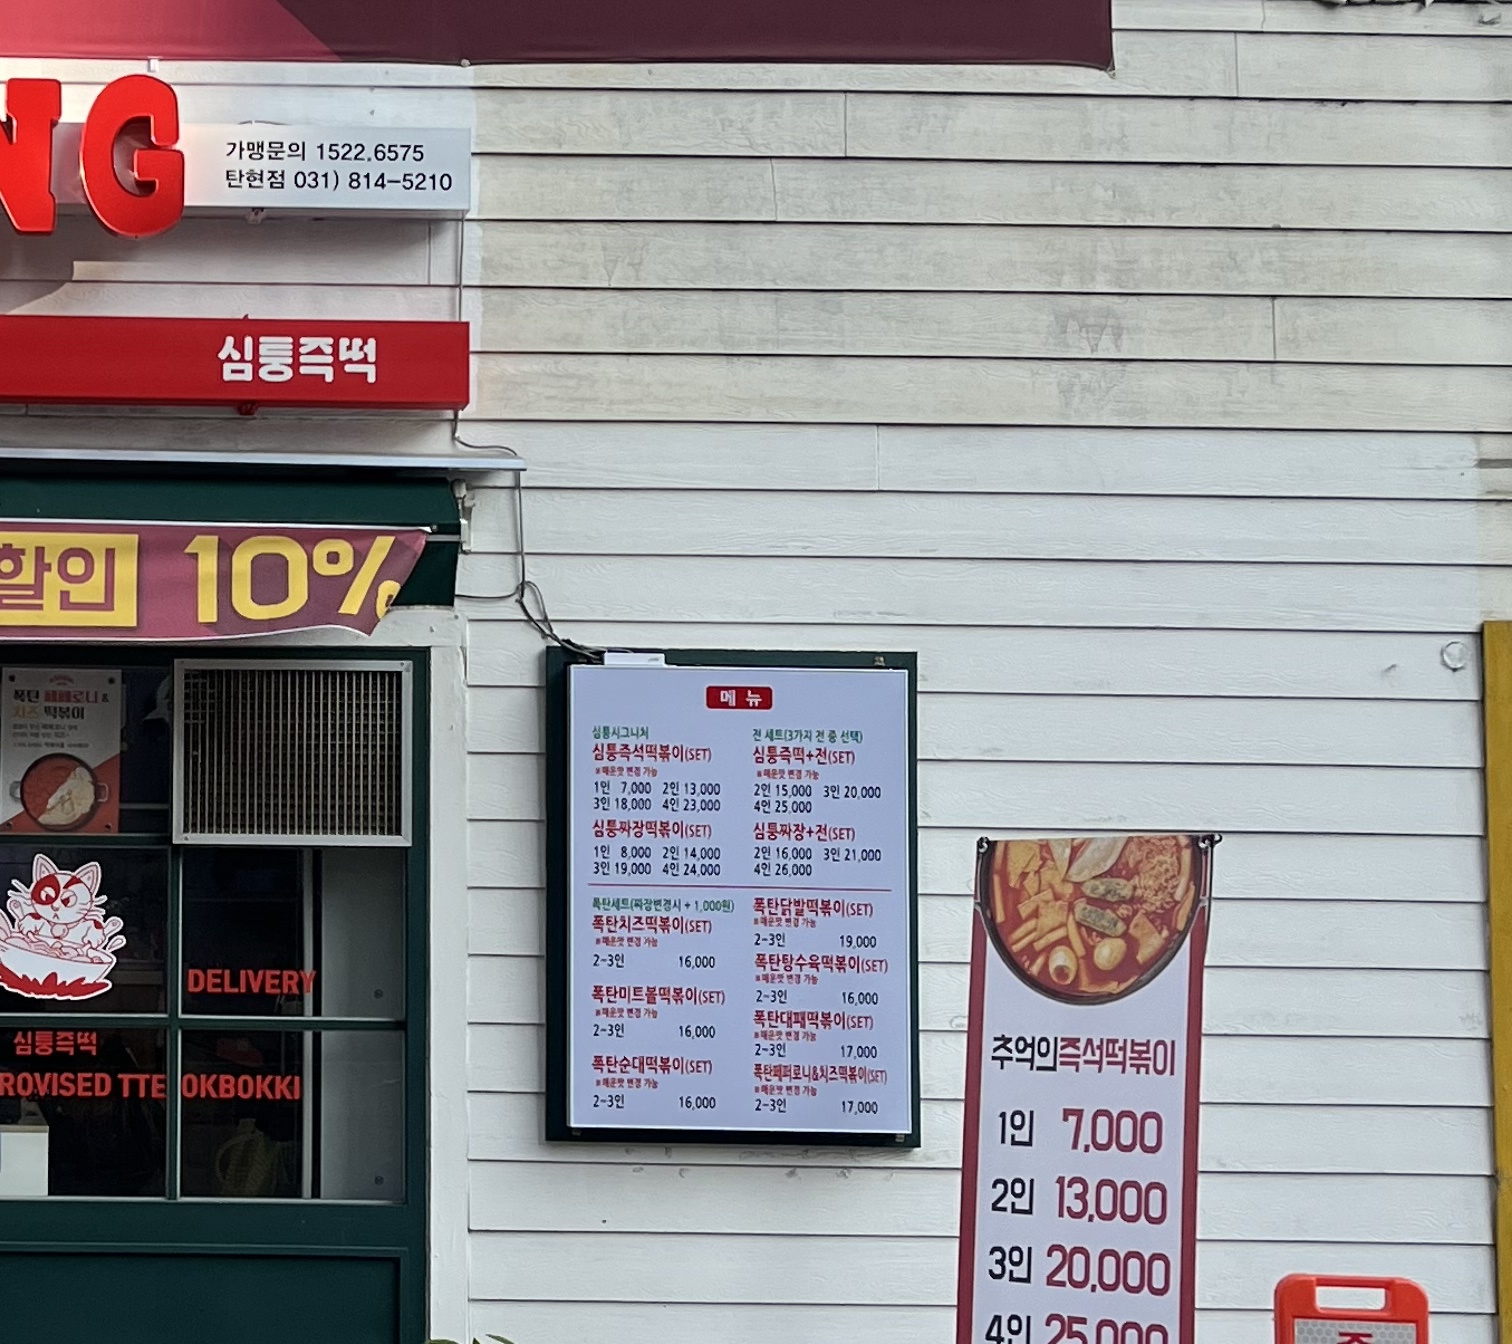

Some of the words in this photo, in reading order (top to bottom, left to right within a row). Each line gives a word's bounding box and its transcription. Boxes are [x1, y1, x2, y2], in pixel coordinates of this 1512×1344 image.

[226, 139, 306, 163] 가맹문의
[226, 169, 285, 191] 탄현점
[294, 170, 340, 191] 031)
[348, 170, 452, 192] 814-5210
[217, 336, 376, 383] 심퉁즉떡
[184, 534, 401, 625] 10%
[594, 780, 610, 795] 1인
[621, 782, 652, 795] 7,000
[662, 781, 679, 796] 2인
[684, 782, 721, 797] 13,000
[754, 783, 771, 797] 2인
[776, 784, 812, 798] 15,000
[823, 785, 840, 799] 3인
[844, 785, 881, 800] 20,000
[593, 797, 610, 811] 3인
[615, 798, 652, 812] 18,000
[662, 798, 679, 812] 4인
[683, 798, 721, 813] 23,000
[754, 800, 771, 814] 4인
[775, 800, 812, 815] 25,000
[594, 845, 610, 859] 1인
[621, 846, 652, 860] 8,000
[662, 846, 679, 860] 2인
[684, 847, 721, 861] 14,000
[754, 846, 771, 860] 2인
[776, 847, 812, 861] 16,000
[824, 847, 840, 862] 3인
[844, 848, 881, 863] 21,000
[593, 861, 610, 876] 3인
[615, 862, 652, 877] 19,000
[662, 863, 679, 877] 4인
[683, 863, 721, 877] 24,000
[754, 862, 771, 877] 4인
[775, 863, 812, 877] 26,000
[839, 935, 877, 949] 19,000
[679, 956, 716, 970] 16,000
[188, 969, 316, 996] DELIVERY
[842, 992, 879, 1007] 16,000
[679, 1025, 716, 1040] 16,000
[840, 1045, 878, 1060] 17,000
[679, 1096, 716, 1111] 16,000
[841, 1101, 878, 1116] 17,000
[999, 1110, 1034, 1147] 1인
[1062, 1108, 1163, 1153] 7,000
[991, 1178, 1034, 1215] 2인
[1055, 1175, 1168, 1225] 13,000
[988, 1246, 1032, 1284] 3인
[1046, 1244, 1171, 1297] 20,000
